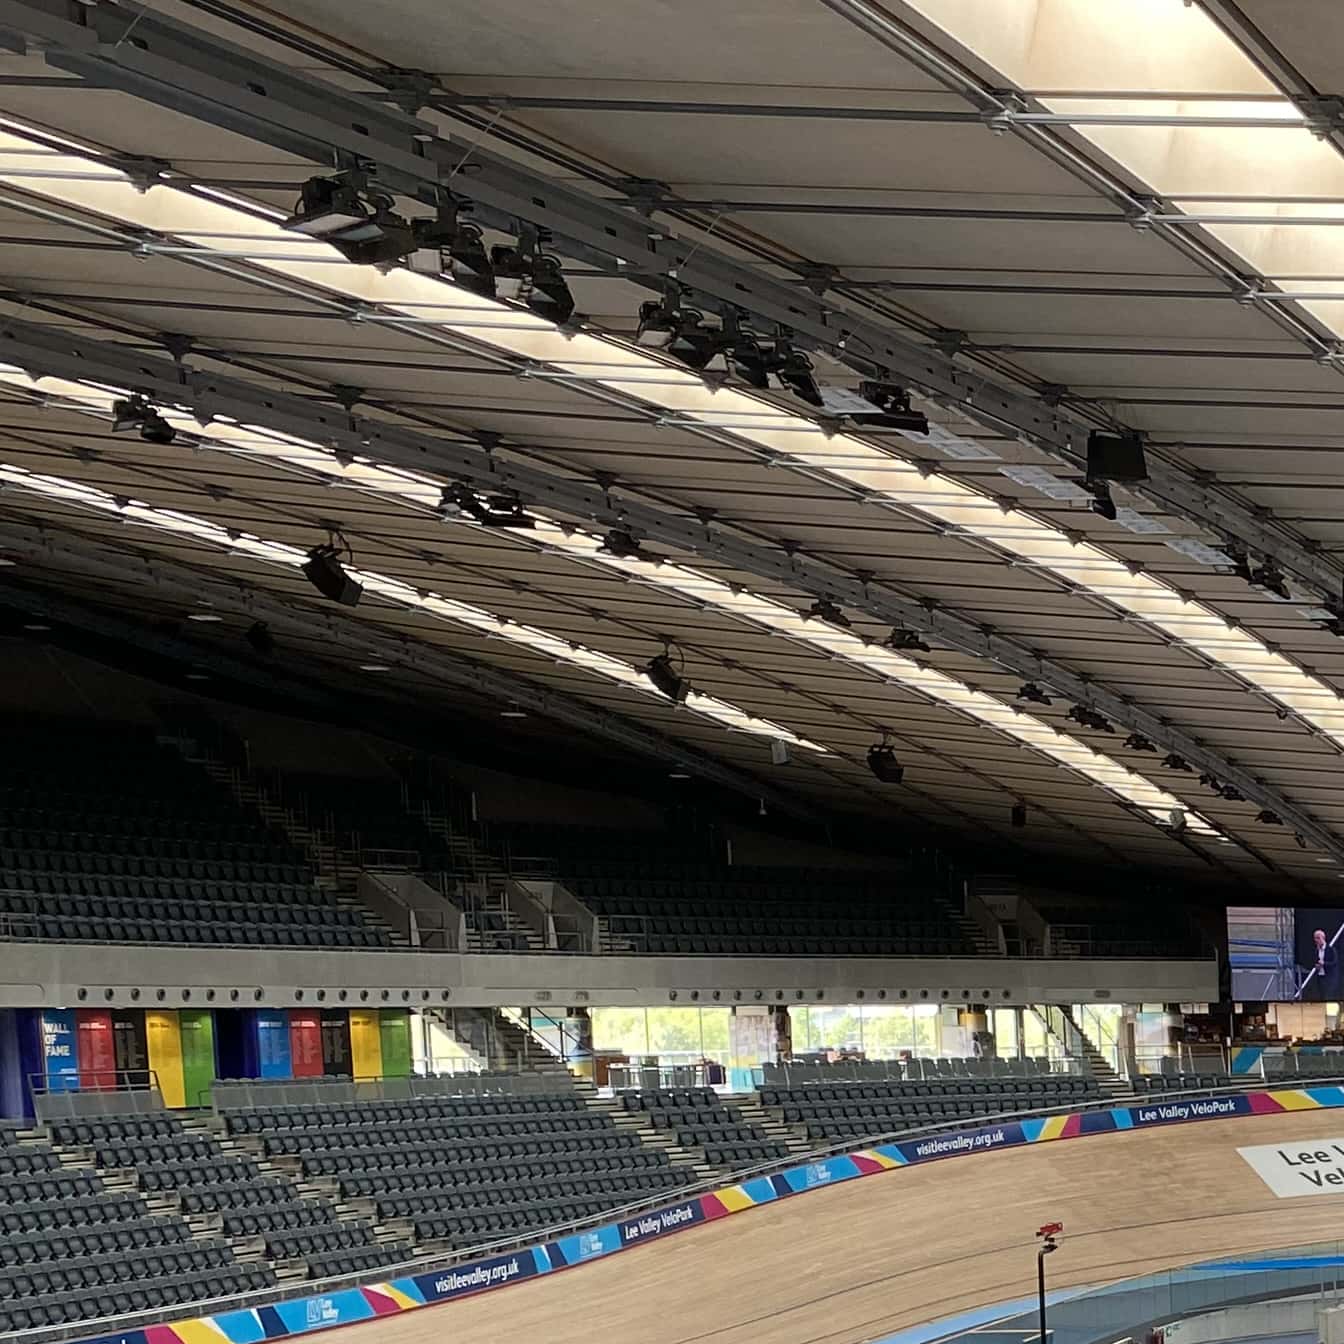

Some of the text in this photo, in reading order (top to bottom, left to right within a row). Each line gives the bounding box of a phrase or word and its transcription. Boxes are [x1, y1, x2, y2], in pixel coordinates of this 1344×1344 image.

[44, 1023, 70, 1034] WALL
[45, 1034, 57, 1045] OF
[46, 1045, 70, 1056] FAME
[1139, 1099, 1236, 1121] Lee Valley VeloPark
[916, 1129, 1005, 1157] visitleevalley.org.uk
[1278, 1150, 1332, 1167] Lee
[625, 1205, 694, 1240] Lee Valley VeloPark
[435, 1258, 520, 1293] visitleevalley.org.uk
